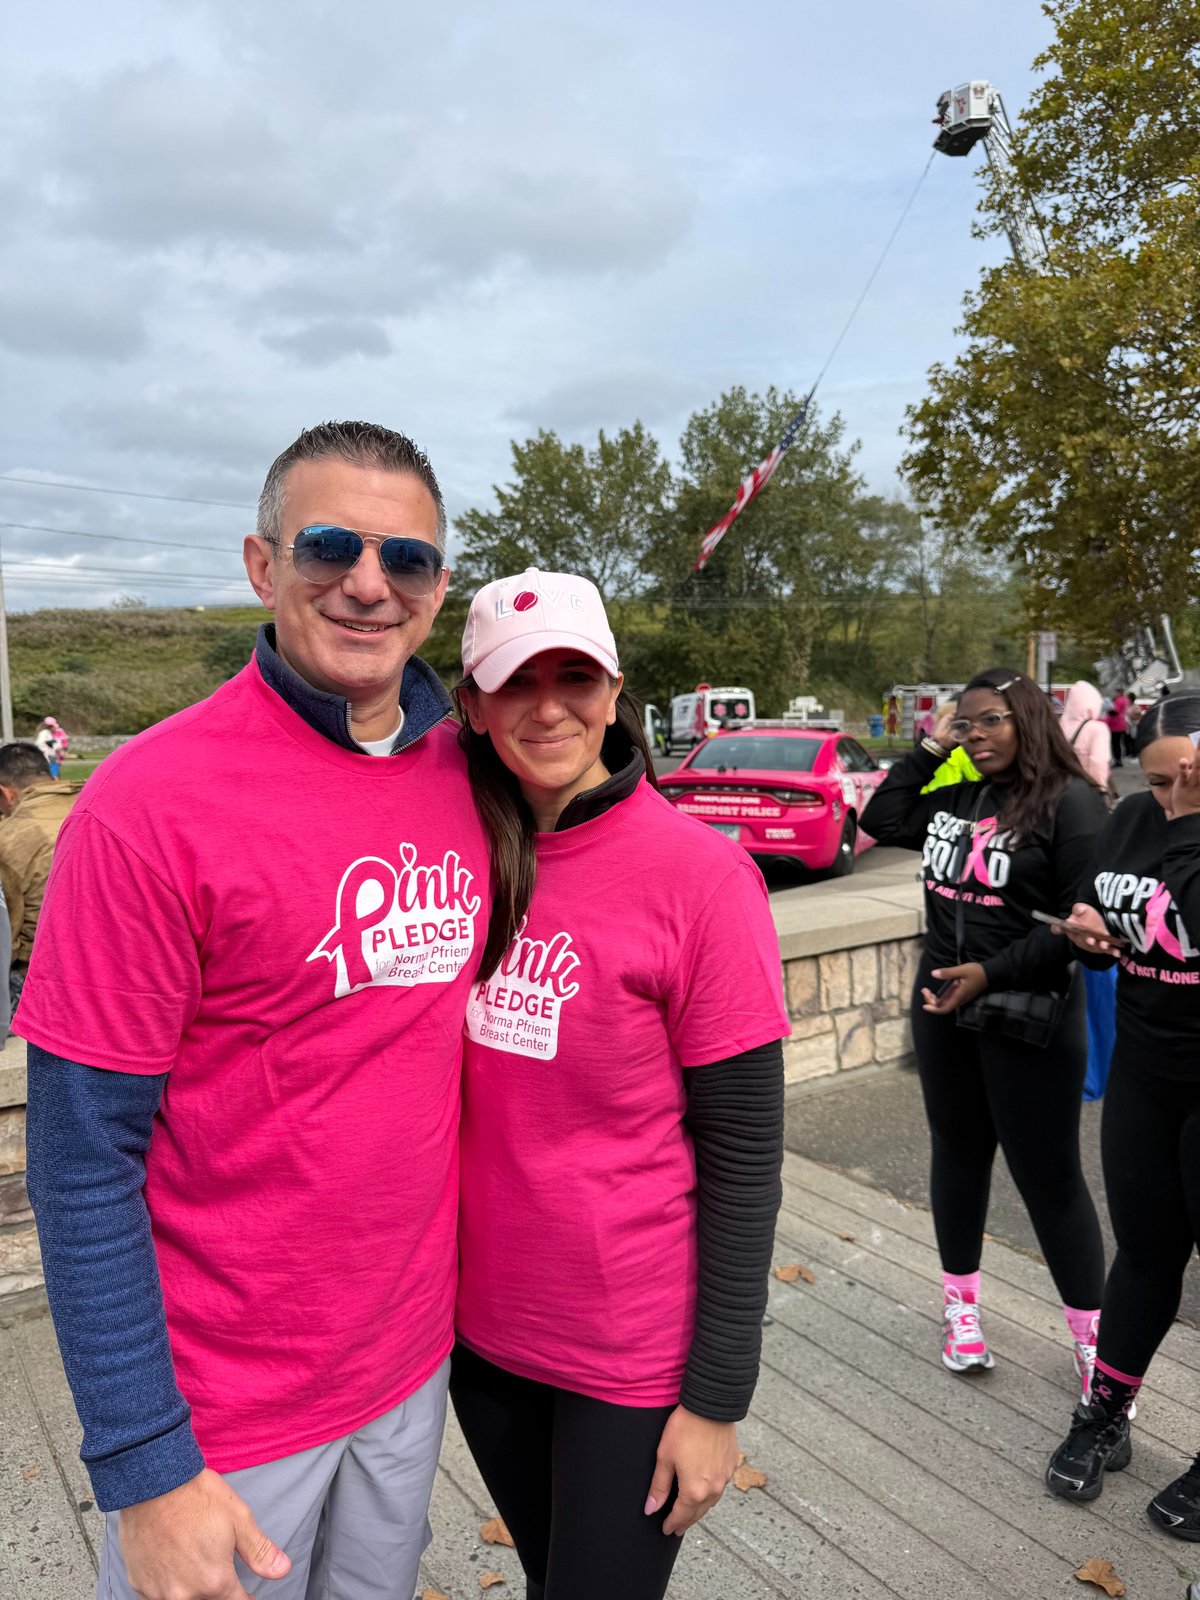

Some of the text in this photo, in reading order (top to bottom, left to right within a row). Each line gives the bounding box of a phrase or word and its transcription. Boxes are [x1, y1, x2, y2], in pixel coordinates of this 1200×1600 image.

[741, 806, 781, 817] POLICE
[372, 917, 470, 953] PLEDGE
[430, 945, 470, 958] Pfriem
[500, 914, 581, 1002] ink
[1159, 969, 1200, 985] ALONE
[475, 982, 555, 1019] PLEDGE
[480, 1024, 549, 1052] Breast Center
[484, 1011, 512, 1030] Norma
[516, 1018, 551, 1038] Pfriem
